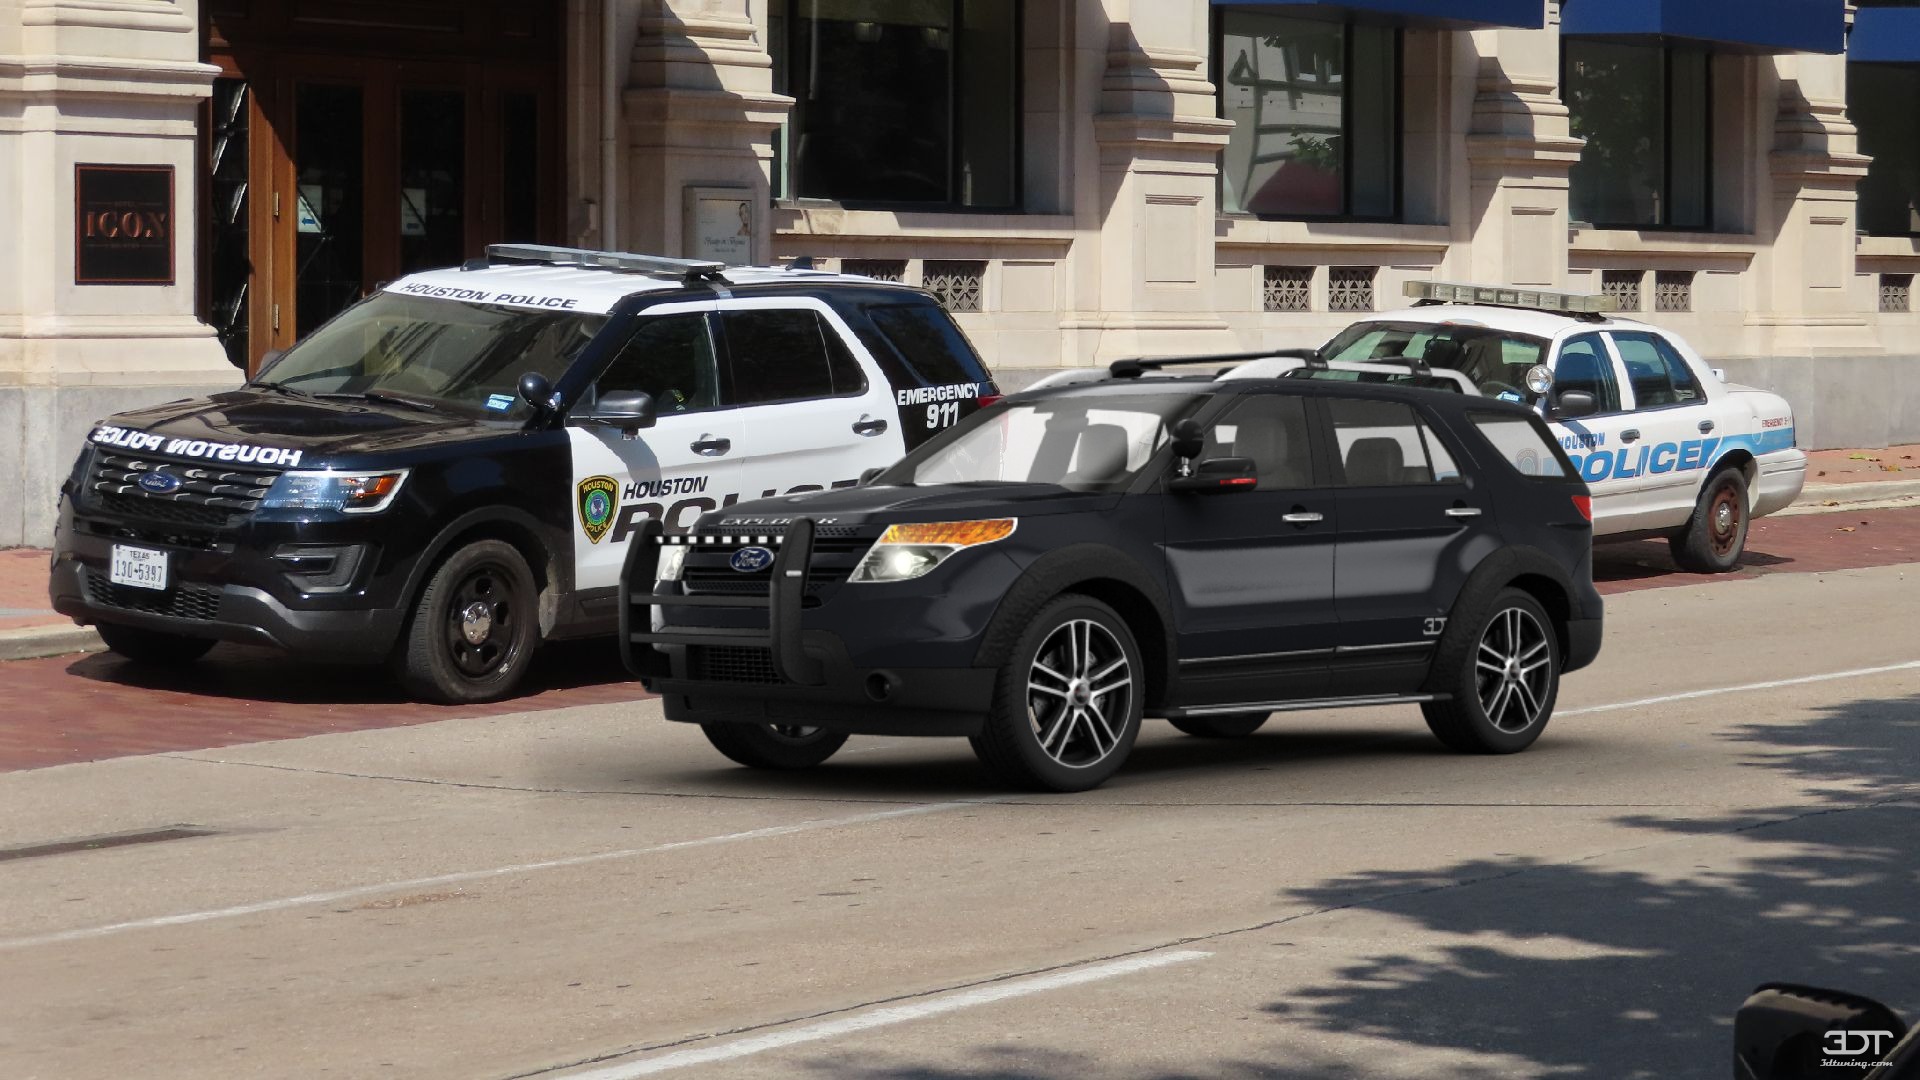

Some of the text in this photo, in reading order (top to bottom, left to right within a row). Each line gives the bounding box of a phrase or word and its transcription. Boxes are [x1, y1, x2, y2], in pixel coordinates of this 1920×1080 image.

[87, 211, 166, 238] ICON
[401, 282, 578, 309] HOUSTON POLICE
[897, 383, 980, 406] EMERGENCY
[926, 401, 959, 429] 911
[583, 480, 614, 494] HOUSTON
[623, 476, 709, 500] HOUSTON
[719, 518, 838, 526] EXPLOR
[130, 550, 150, 560] TEXAS
[735, 549, 766, 568] Ford
